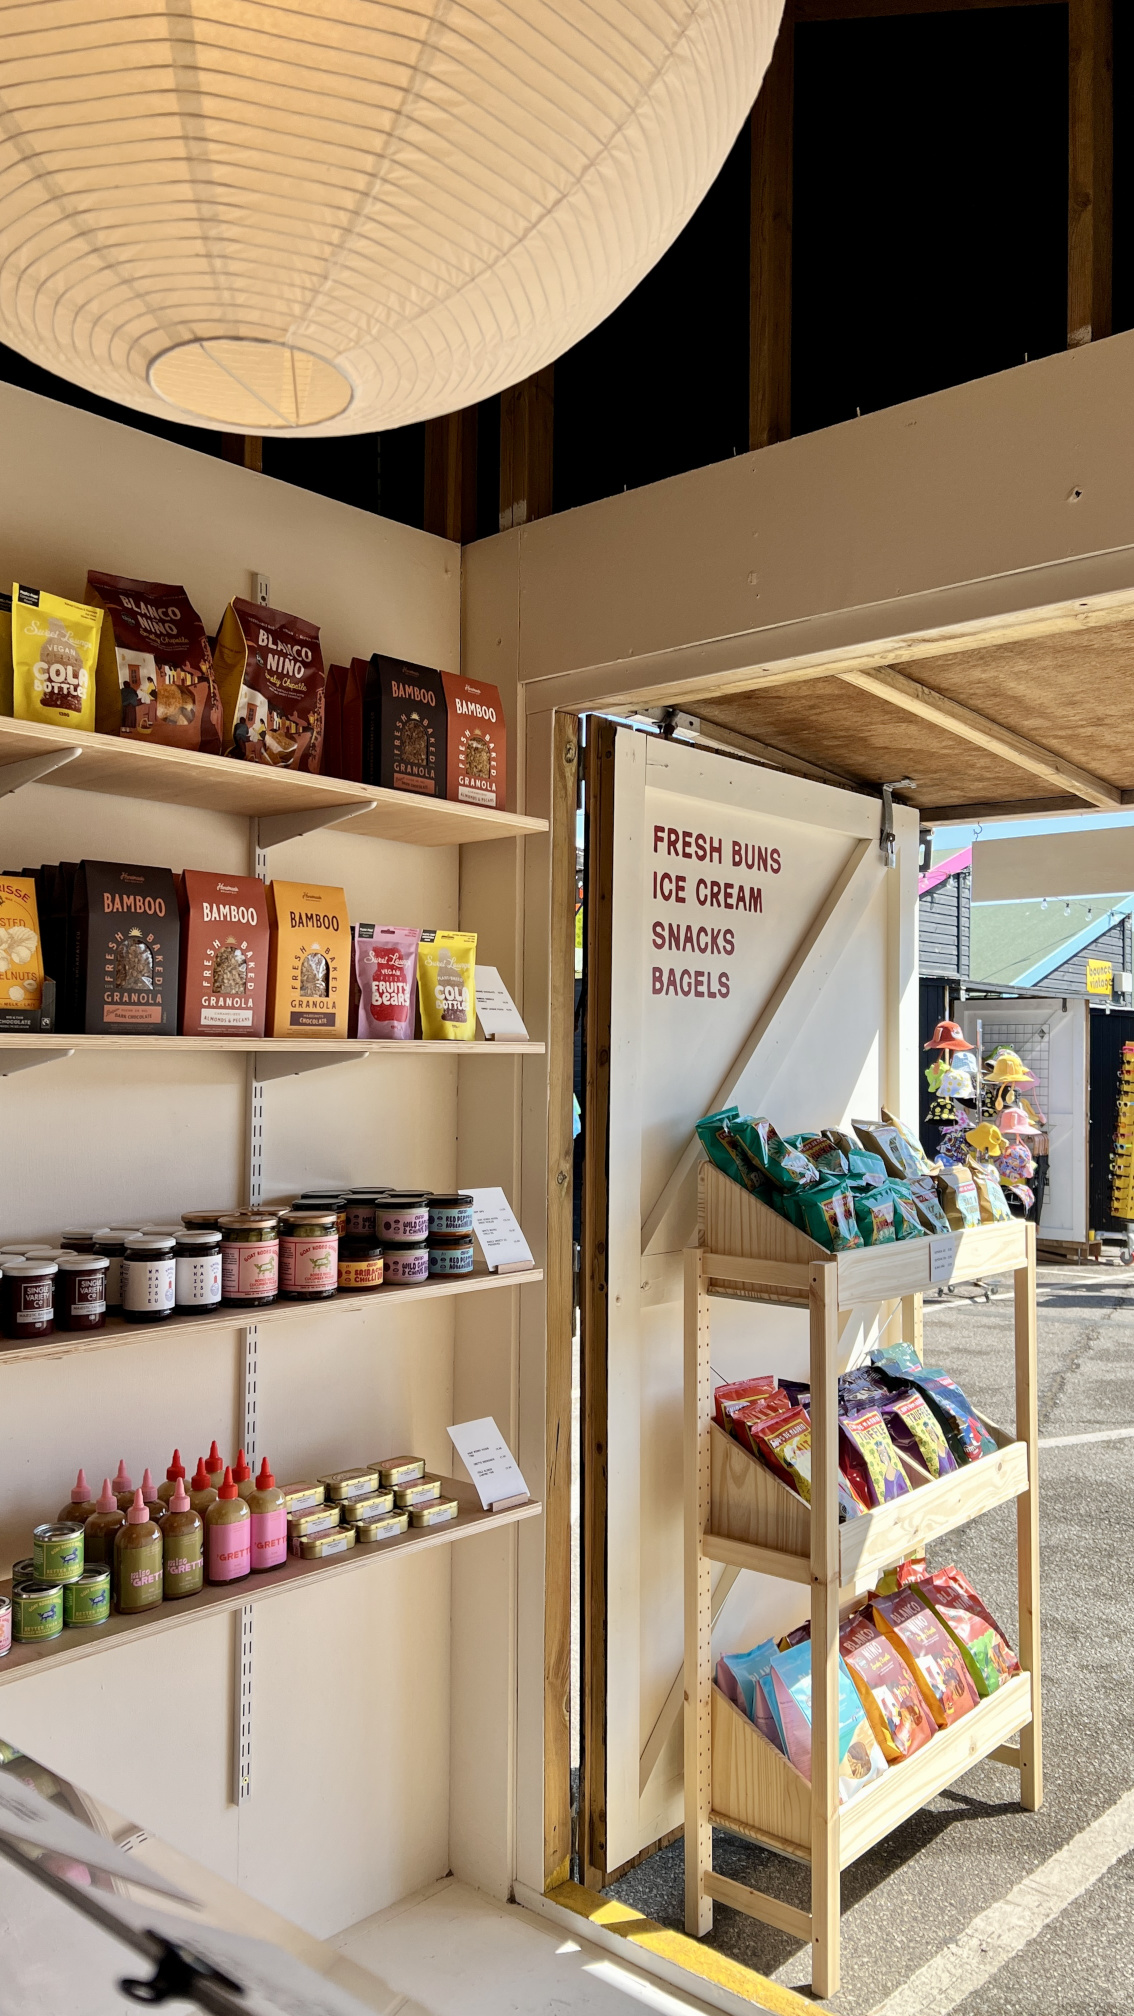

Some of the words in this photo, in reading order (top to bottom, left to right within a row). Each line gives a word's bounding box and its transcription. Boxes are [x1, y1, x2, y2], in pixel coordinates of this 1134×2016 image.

[119, 594, 181, 620] BLANCO
[137, 614, 178, 635] NIÑO
[47, 644, 76, 656] VEGAN
[258, 628, 312, 662] BLANCO
[33, 661, 88, 686] COLA
[267, 653, 304, 679] NIÑO
[392, 680, 436, 707] BAMBOO
[455, 698, 496, 723] BAMBOO
[393, 762, 435, 779] GRANOLA
[458, 775, 497, 792] GRANOLA
[653, 825, 722, 864] FRESH
[732, 840, 781, 874] BUNS
[653, 871, 687, 904] ICE
[695, 878, 763, 914] CREAM
[103, 893, 165, 918] BAMBOO
[202, 902, 258, 926] BAMBOO
[289, 911, 340, 932] BAMBOO
[652, 921, 735, 956] SNACKS
[372, 981, 409, 995] FRUITY
[651, 966, 730, 999] BAGELS
[104, 991, 162, 1004] GRANOLA
[201, 996, 254, 1008] GRANOLA
[434, 985, 469, 1002] COLA
[290, 1000, 336, 1010] GRANOLA
[27, 1286, 49, 1294] SINGLE
[80, 1286, 103, 1294] VARIETY
[81, 1279, 103, 1287] SINGLE
[25, 1292, 50, 1301] VARIETY
[906, 1406, 931, 1423] TRUFFLE
[782, 1431, 791, 1439] DE
[788, 1423, 807, 1436] MADRID
[168, 1558, 188, 1567] miso
[131, 1569, 151, 1580] miso
[890, 1601, 921, 1624] BLANCO
[843, 1628, 875, 1652] BLANCO
